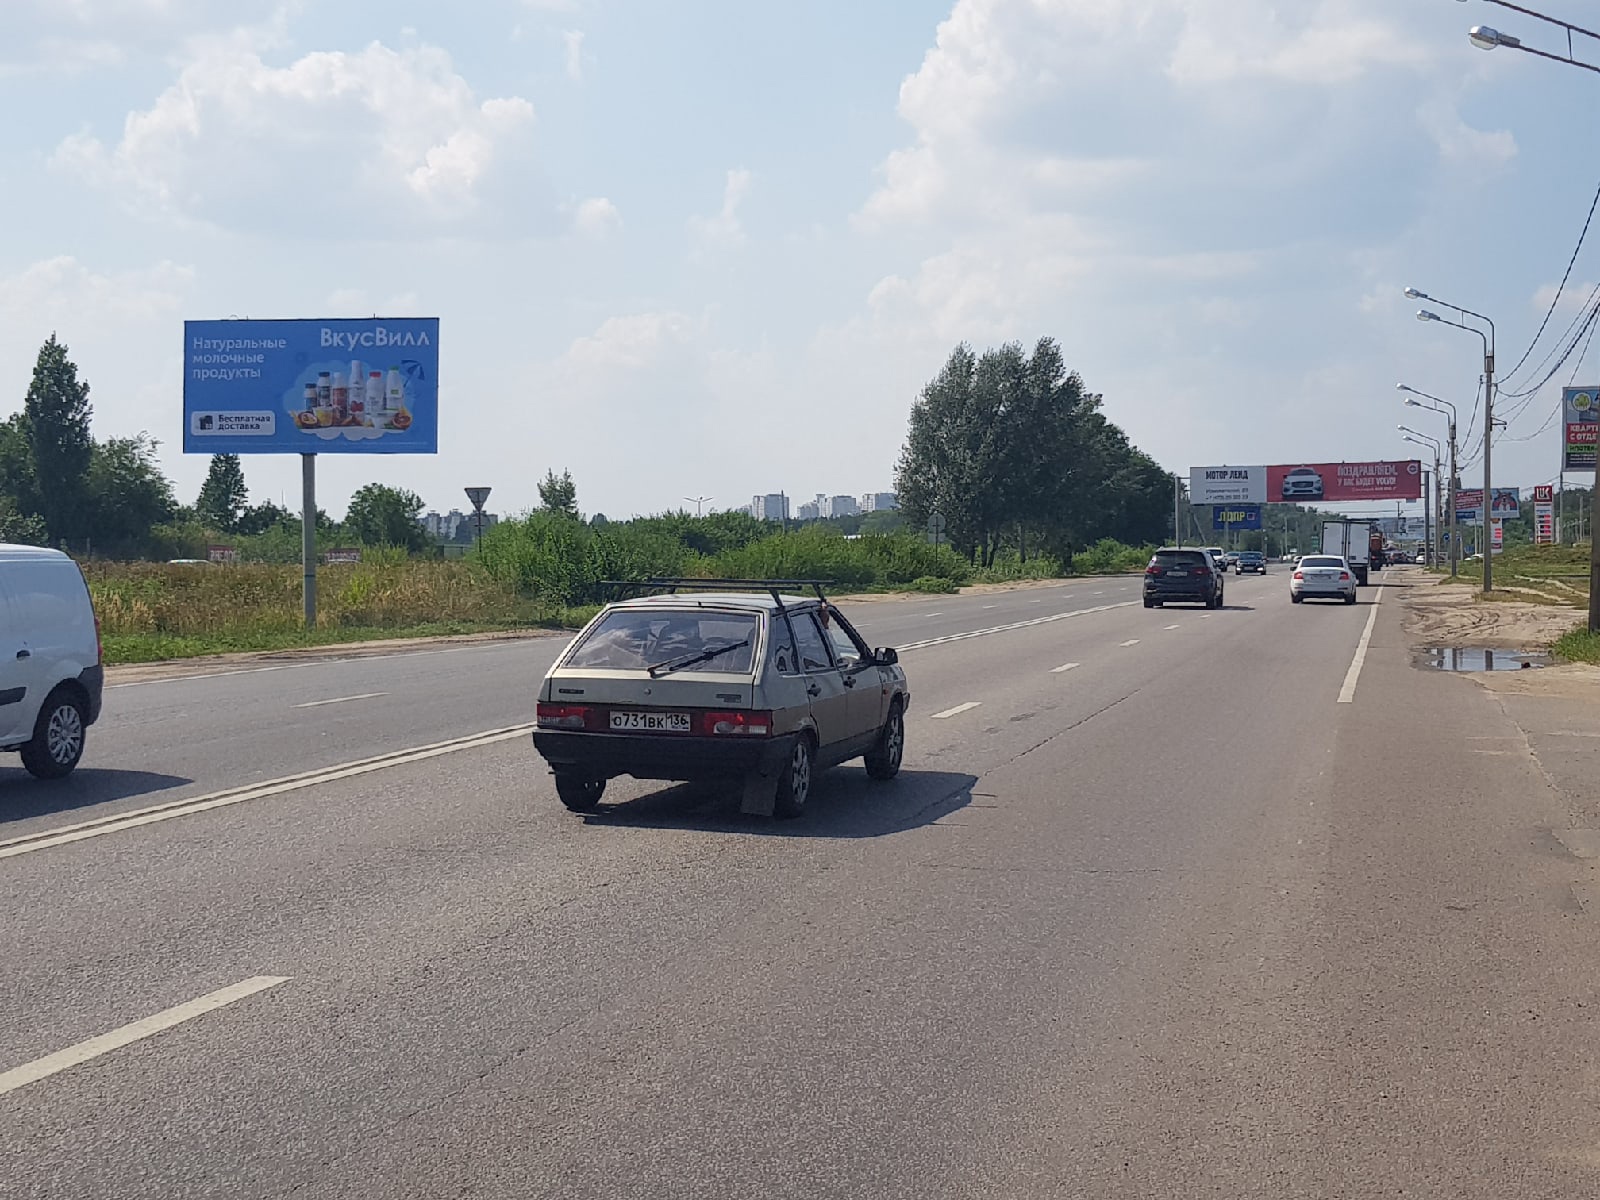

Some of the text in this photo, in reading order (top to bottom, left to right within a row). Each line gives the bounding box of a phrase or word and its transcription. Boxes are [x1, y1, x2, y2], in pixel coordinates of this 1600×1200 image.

[193, 337, 287, 352] Натуральные
[320, 327, 430, 351] ВкусВилл
[193, 353, 265, 364] молочные
[193, 367, 261, 381] продукты
[218, 414, 271, 423] Бесплатная
[218, 423, 261, 431] доставка
[1206, 470, 1248, 479] МОТОР ЛЕНД
